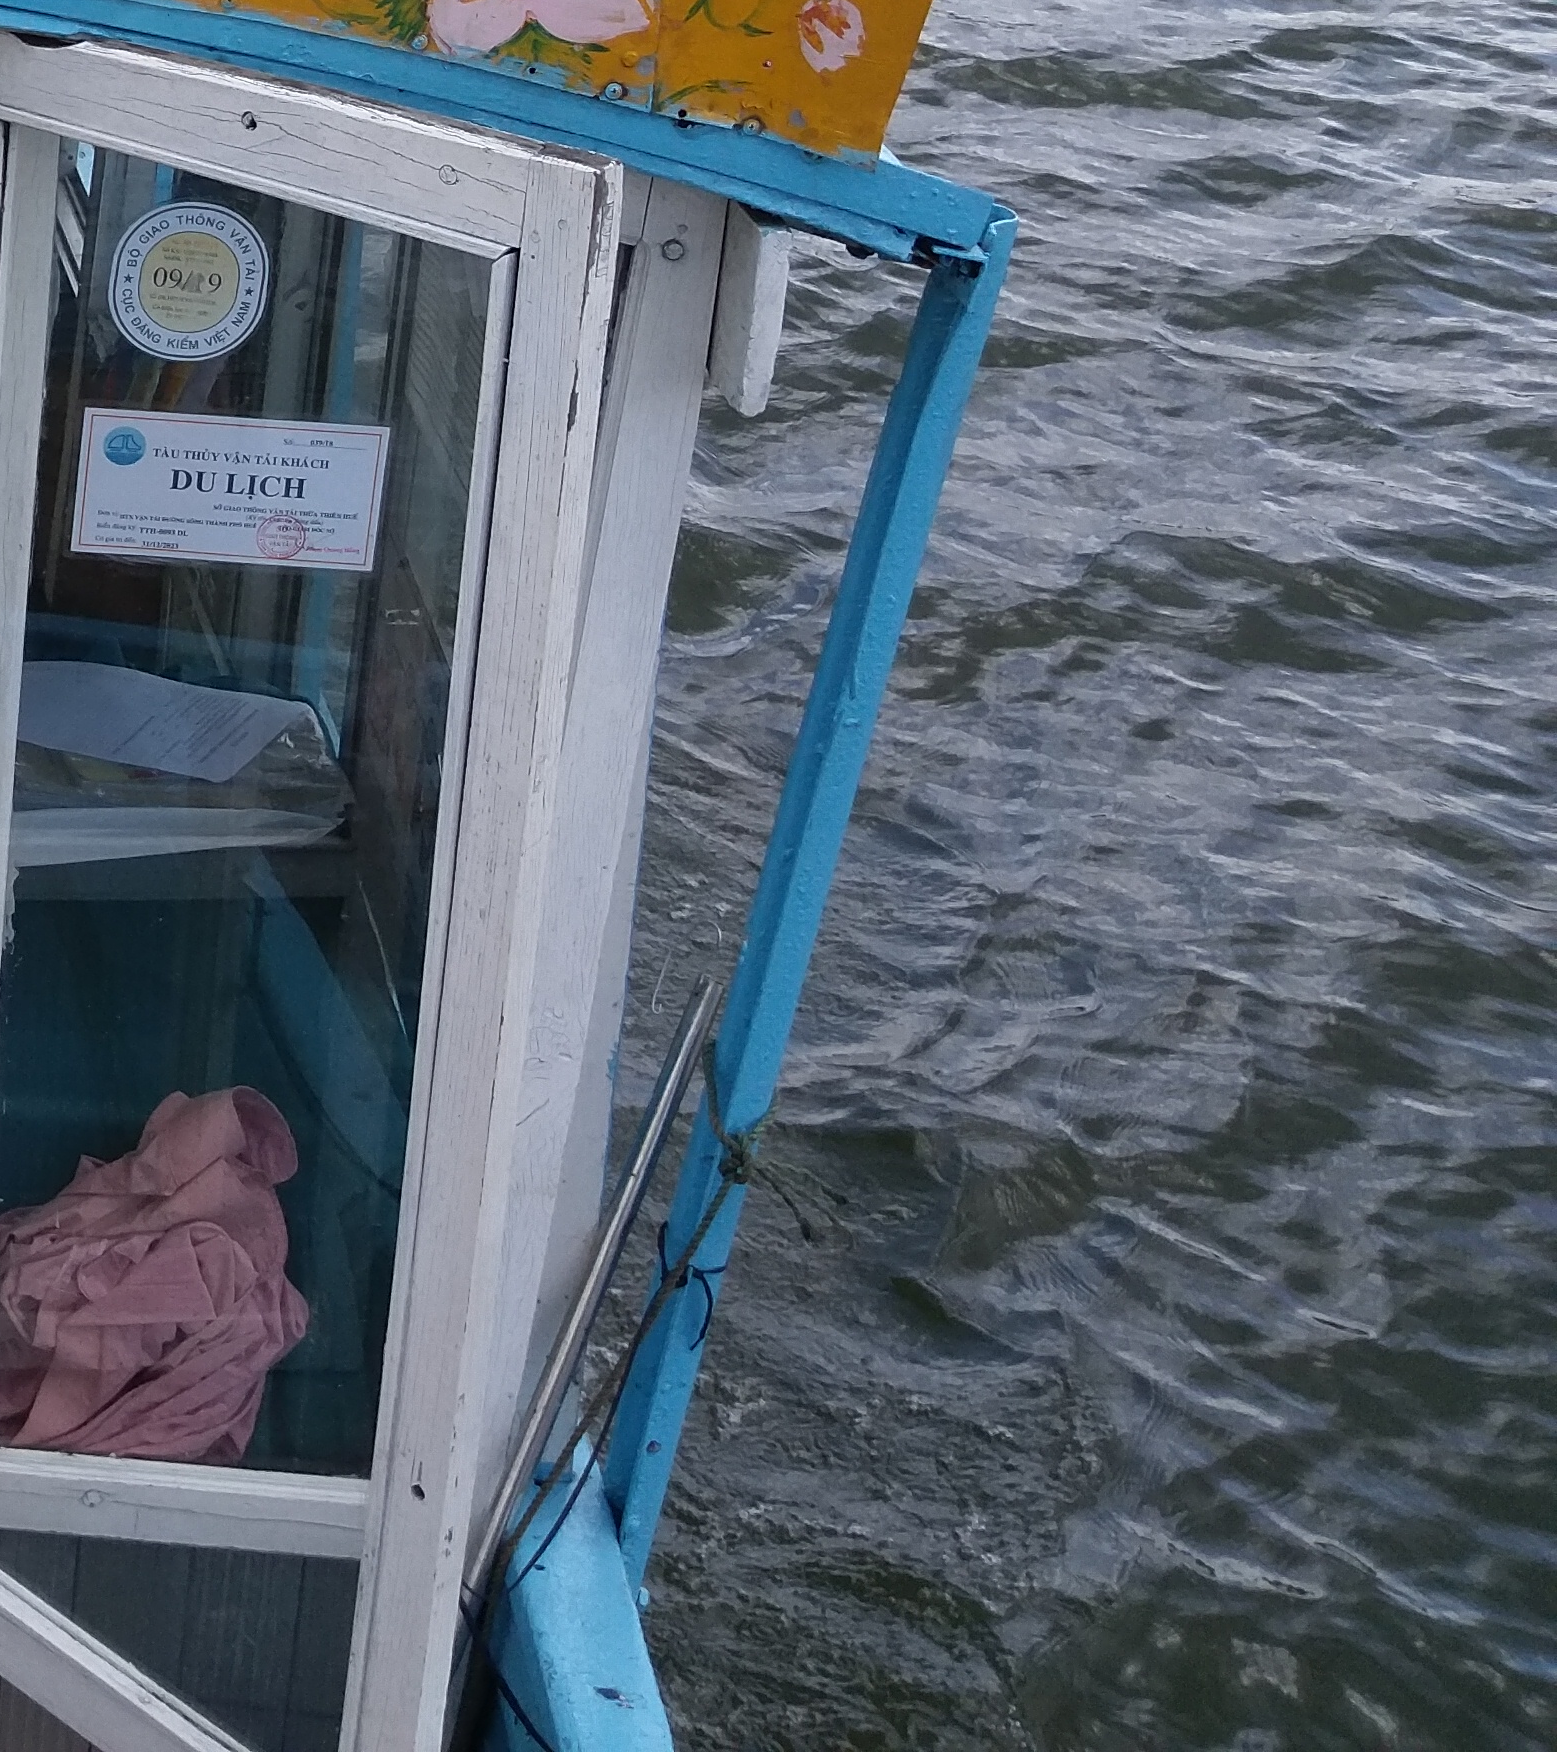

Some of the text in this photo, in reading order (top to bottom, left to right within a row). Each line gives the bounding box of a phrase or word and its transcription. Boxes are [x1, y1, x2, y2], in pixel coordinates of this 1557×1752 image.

[126, 248, 143, 267] BỘ
[138, 219, 170, 244] GIAO
[176, 213, 226, 231] THÔNG
[203, 326, 231, 347] VIỆT
[231, 300, 252, 328] NAM
[152, 446, 330, 470] TÀU THỦY VẬN TẢI KHÁCH
[169, 469, 307, 500] DU LỊCH
